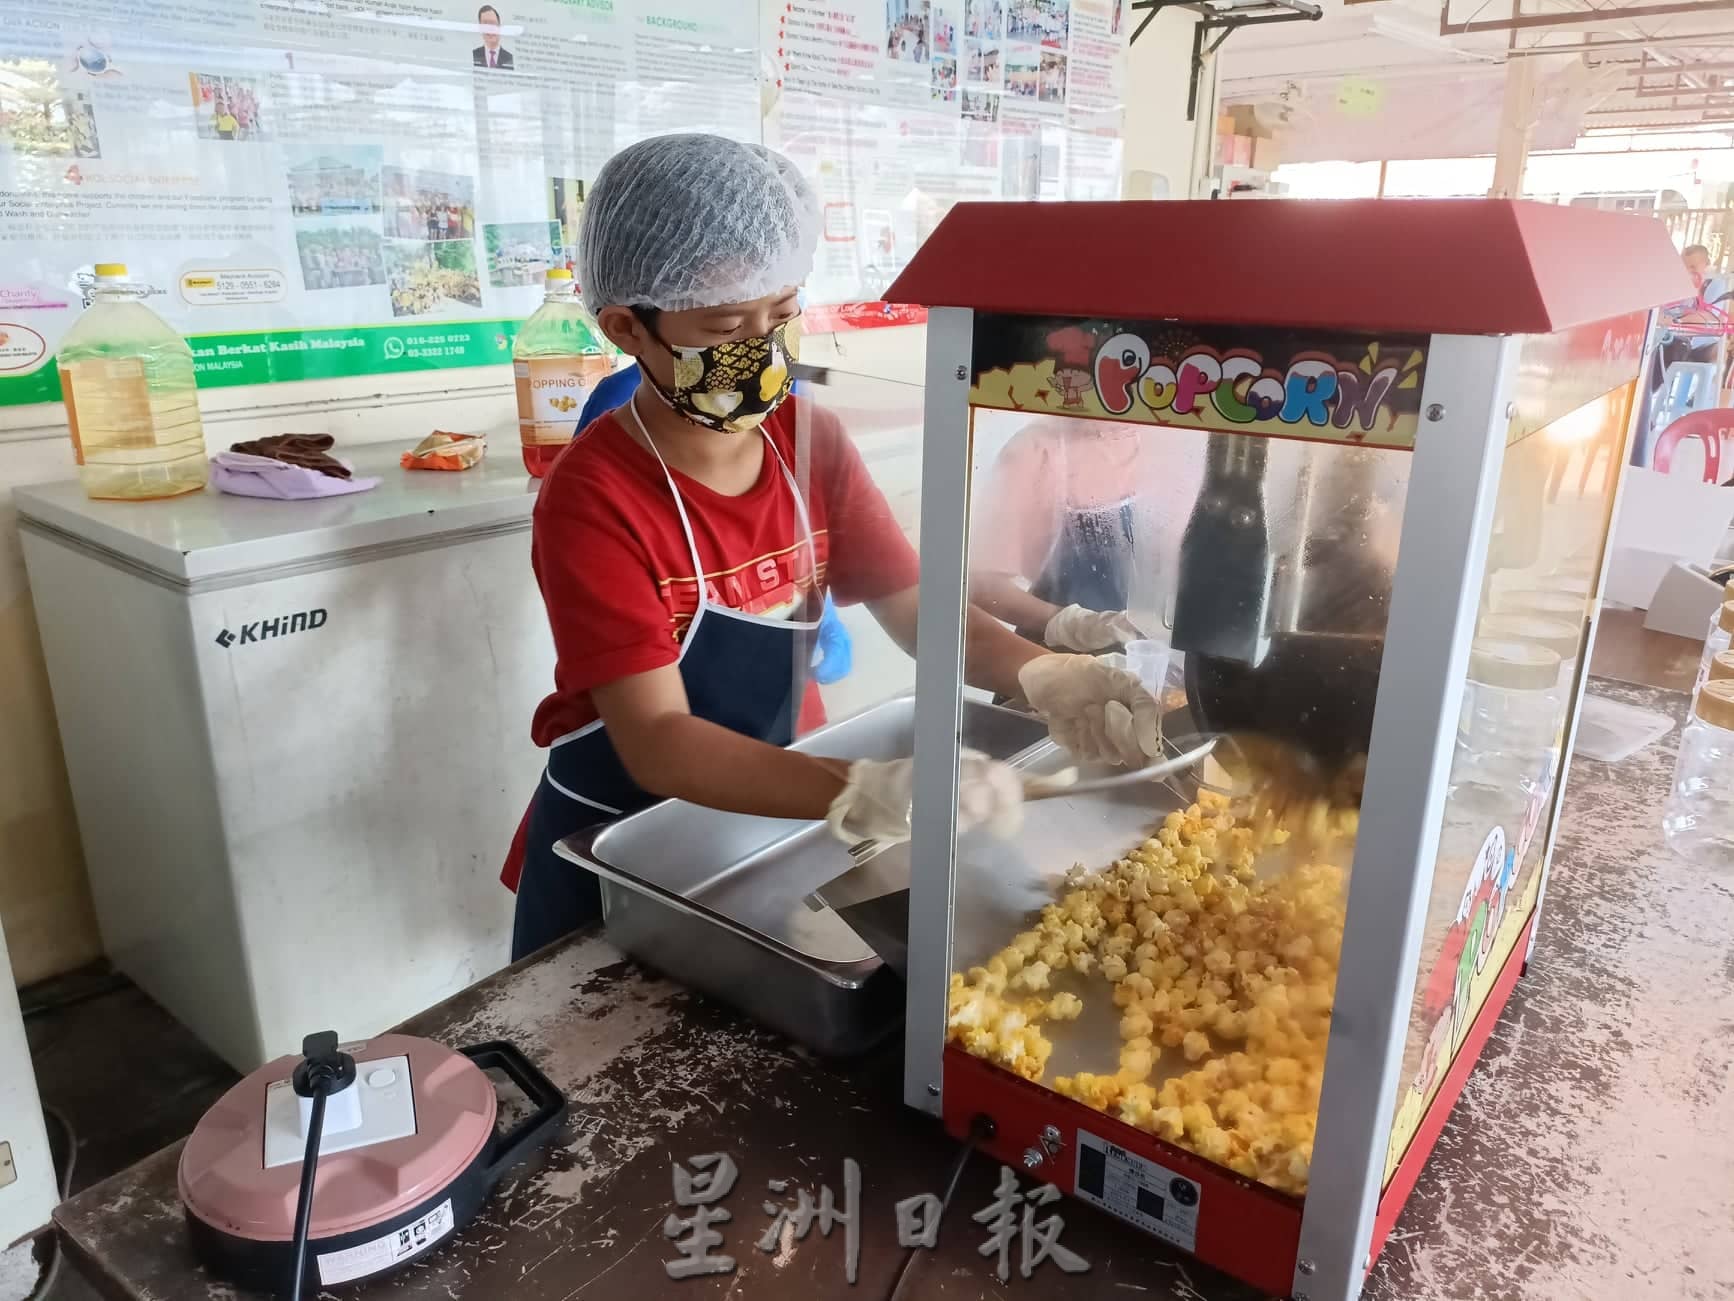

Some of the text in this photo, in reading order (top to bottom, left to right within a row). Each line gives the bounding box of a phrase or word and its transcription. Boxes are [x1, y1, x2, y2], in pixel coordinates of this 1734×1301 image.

[217, 343, 267, 356] Berkat
[268, 340, 309, 353] Kasih
[310, 336, 366, 351] Malaysia
[206, 359, 243, 371] MALAYSIA
